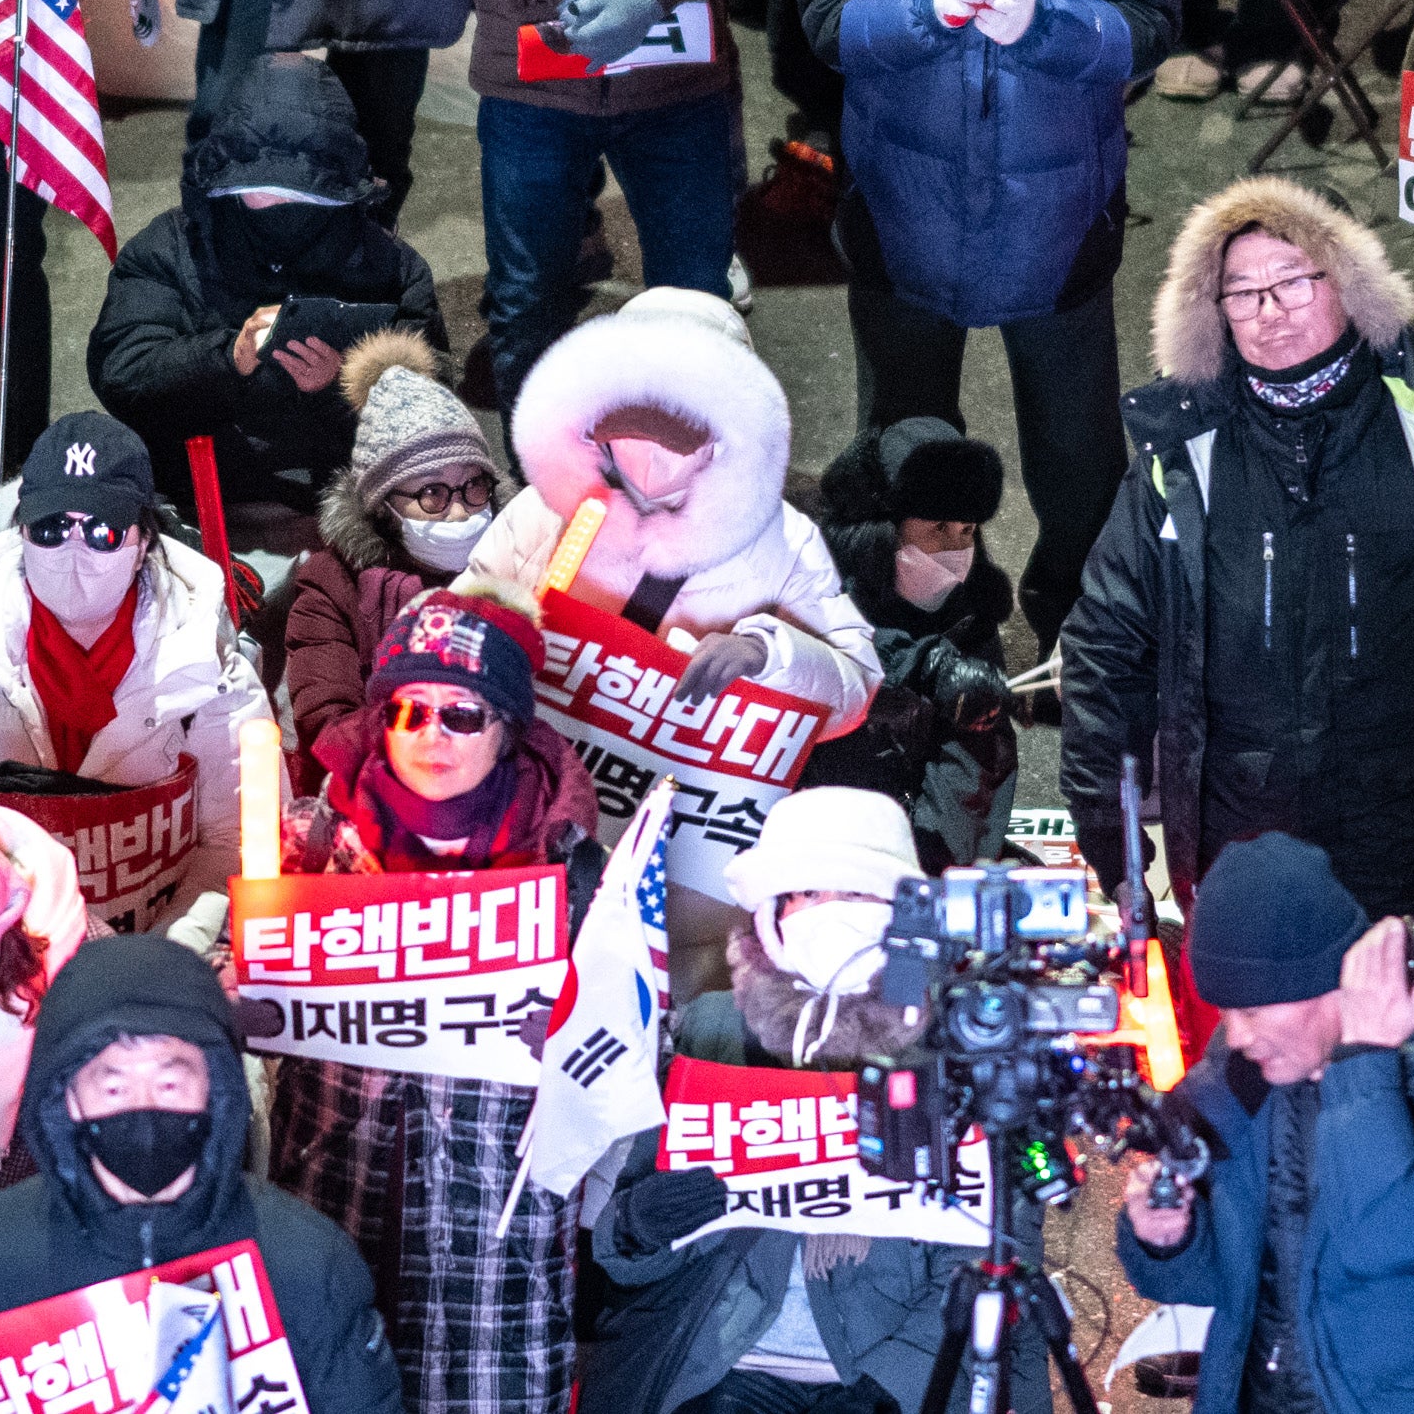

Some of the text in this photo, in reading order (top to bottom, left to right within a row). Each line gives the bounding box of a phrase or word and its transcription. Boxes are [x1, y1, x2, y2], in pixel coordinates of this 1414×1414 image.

[64, 442, 96, 476] NY
[535, 630, 819, 781] 탄핵반대
[243, 875, 557, 982] 탄핵반대
